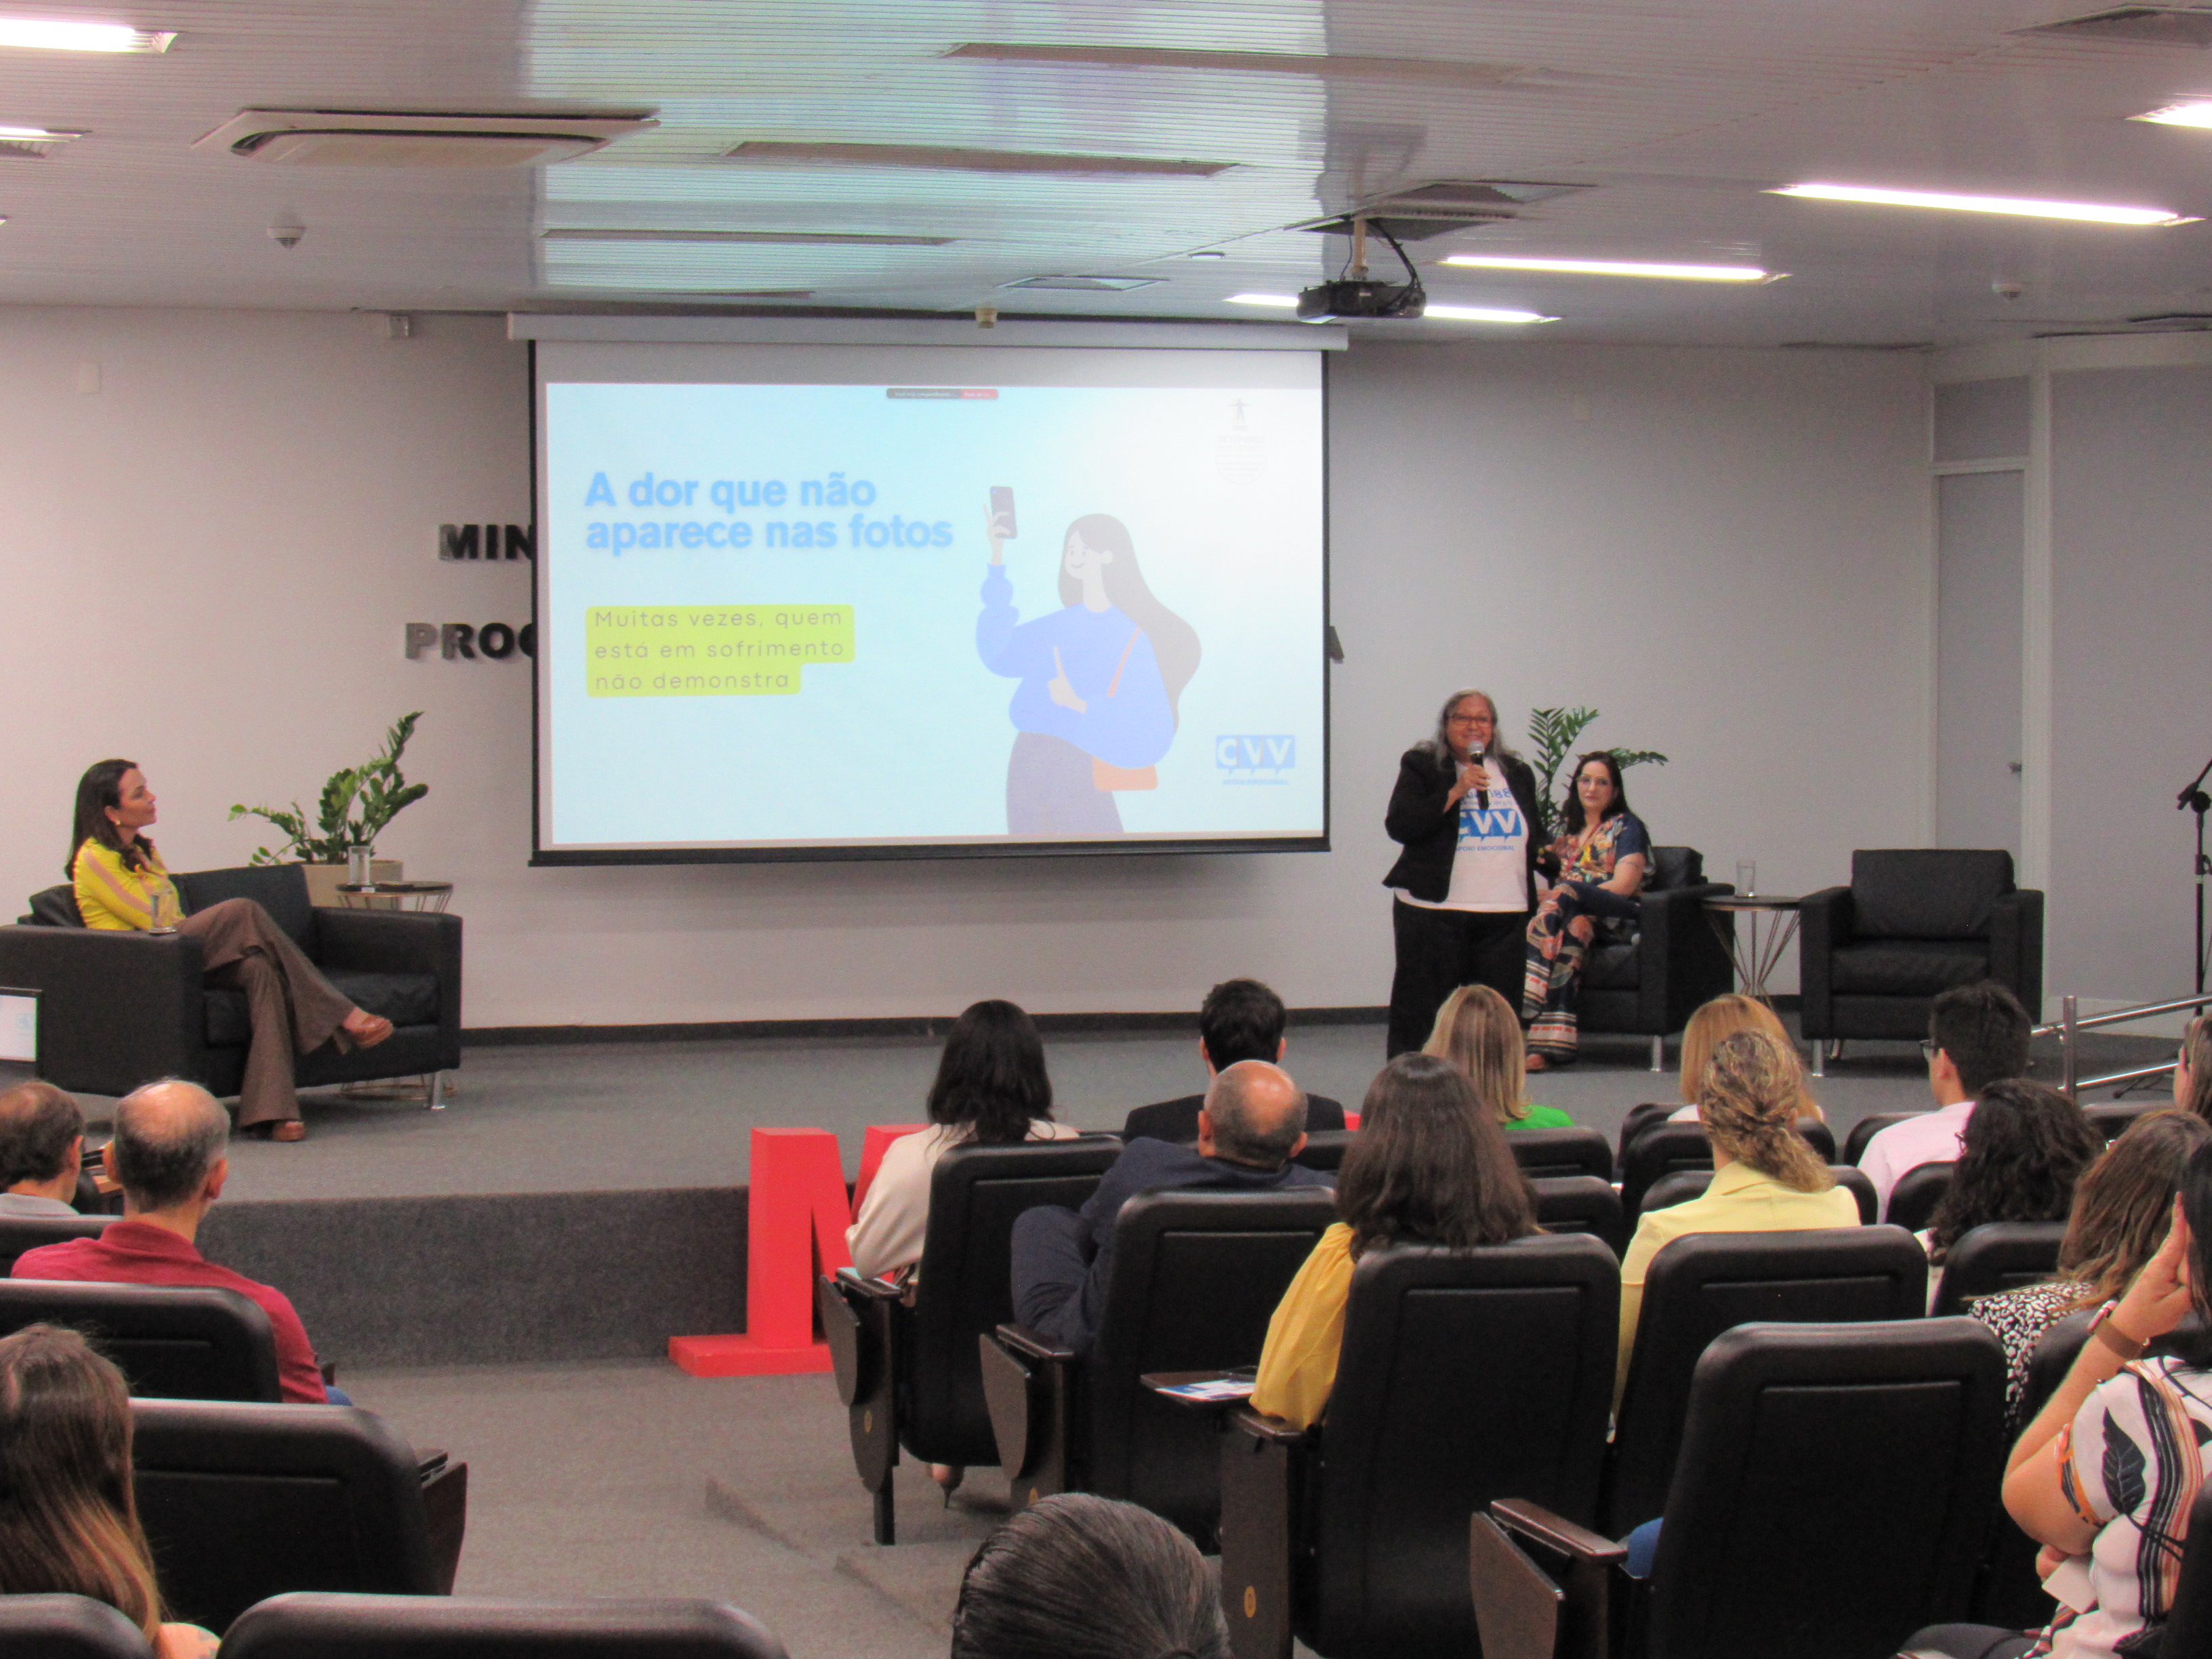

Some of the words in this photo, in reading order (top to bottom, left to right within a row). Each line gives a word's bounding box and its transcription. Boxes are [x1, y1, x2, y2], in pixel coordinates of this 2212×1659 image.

[585, 472, 617, 507] A
[628, 472, 699, 507] dor
[710, 480, 787, 514] que
[800, 472, 877, 507] não
[586, 521, 754, 557] aparece
[766, 520, 838, 548] nas
[848, 513, 954, 548] fotos
[596, 611, 678, 627] Muitas
[689, 613, 764, 627] vezes,
[775, 612, 842, 629] quem
[595, 642, 649, 658] está
[660, 644, 695, 657] em
[707, 640, 844, 657] sofrimento
[596, 674, 642, 689] não
[653, 672, 789, 689] demonstra
[1218, 738, 1292, 766] CVV
